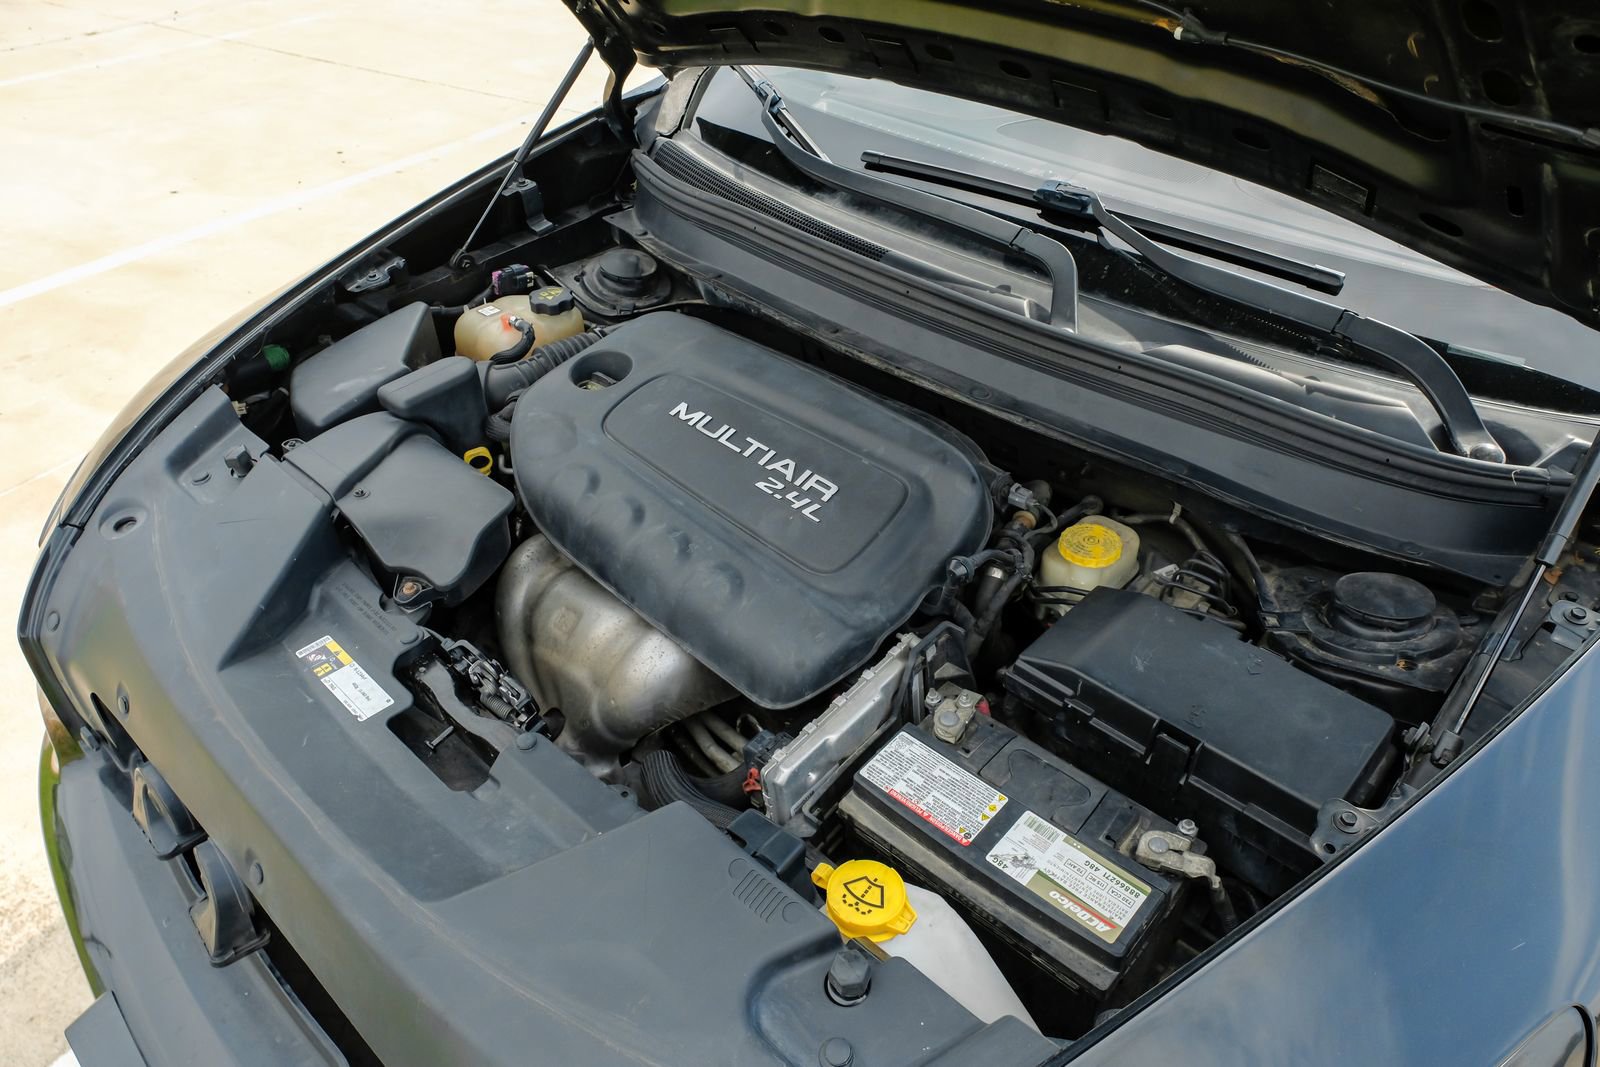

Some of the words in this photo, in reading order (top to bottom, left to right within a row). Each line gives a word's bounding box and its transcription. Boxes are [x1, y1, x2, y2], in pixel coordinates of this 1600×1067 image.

[669, 401, 839, 502] MULTIAIR
[755, 477, 822, 522] 2.4L
[990, 856, 1009, 870] 48G
[1082, 859, 1101, 873] 48G
[1102, 871, 1141, 899] 88866271
[1109, 888, 1122, 898] CCA
[1048, 889, 1112, 932] ACDelco
[1120, 895, 1132, 905] 730
